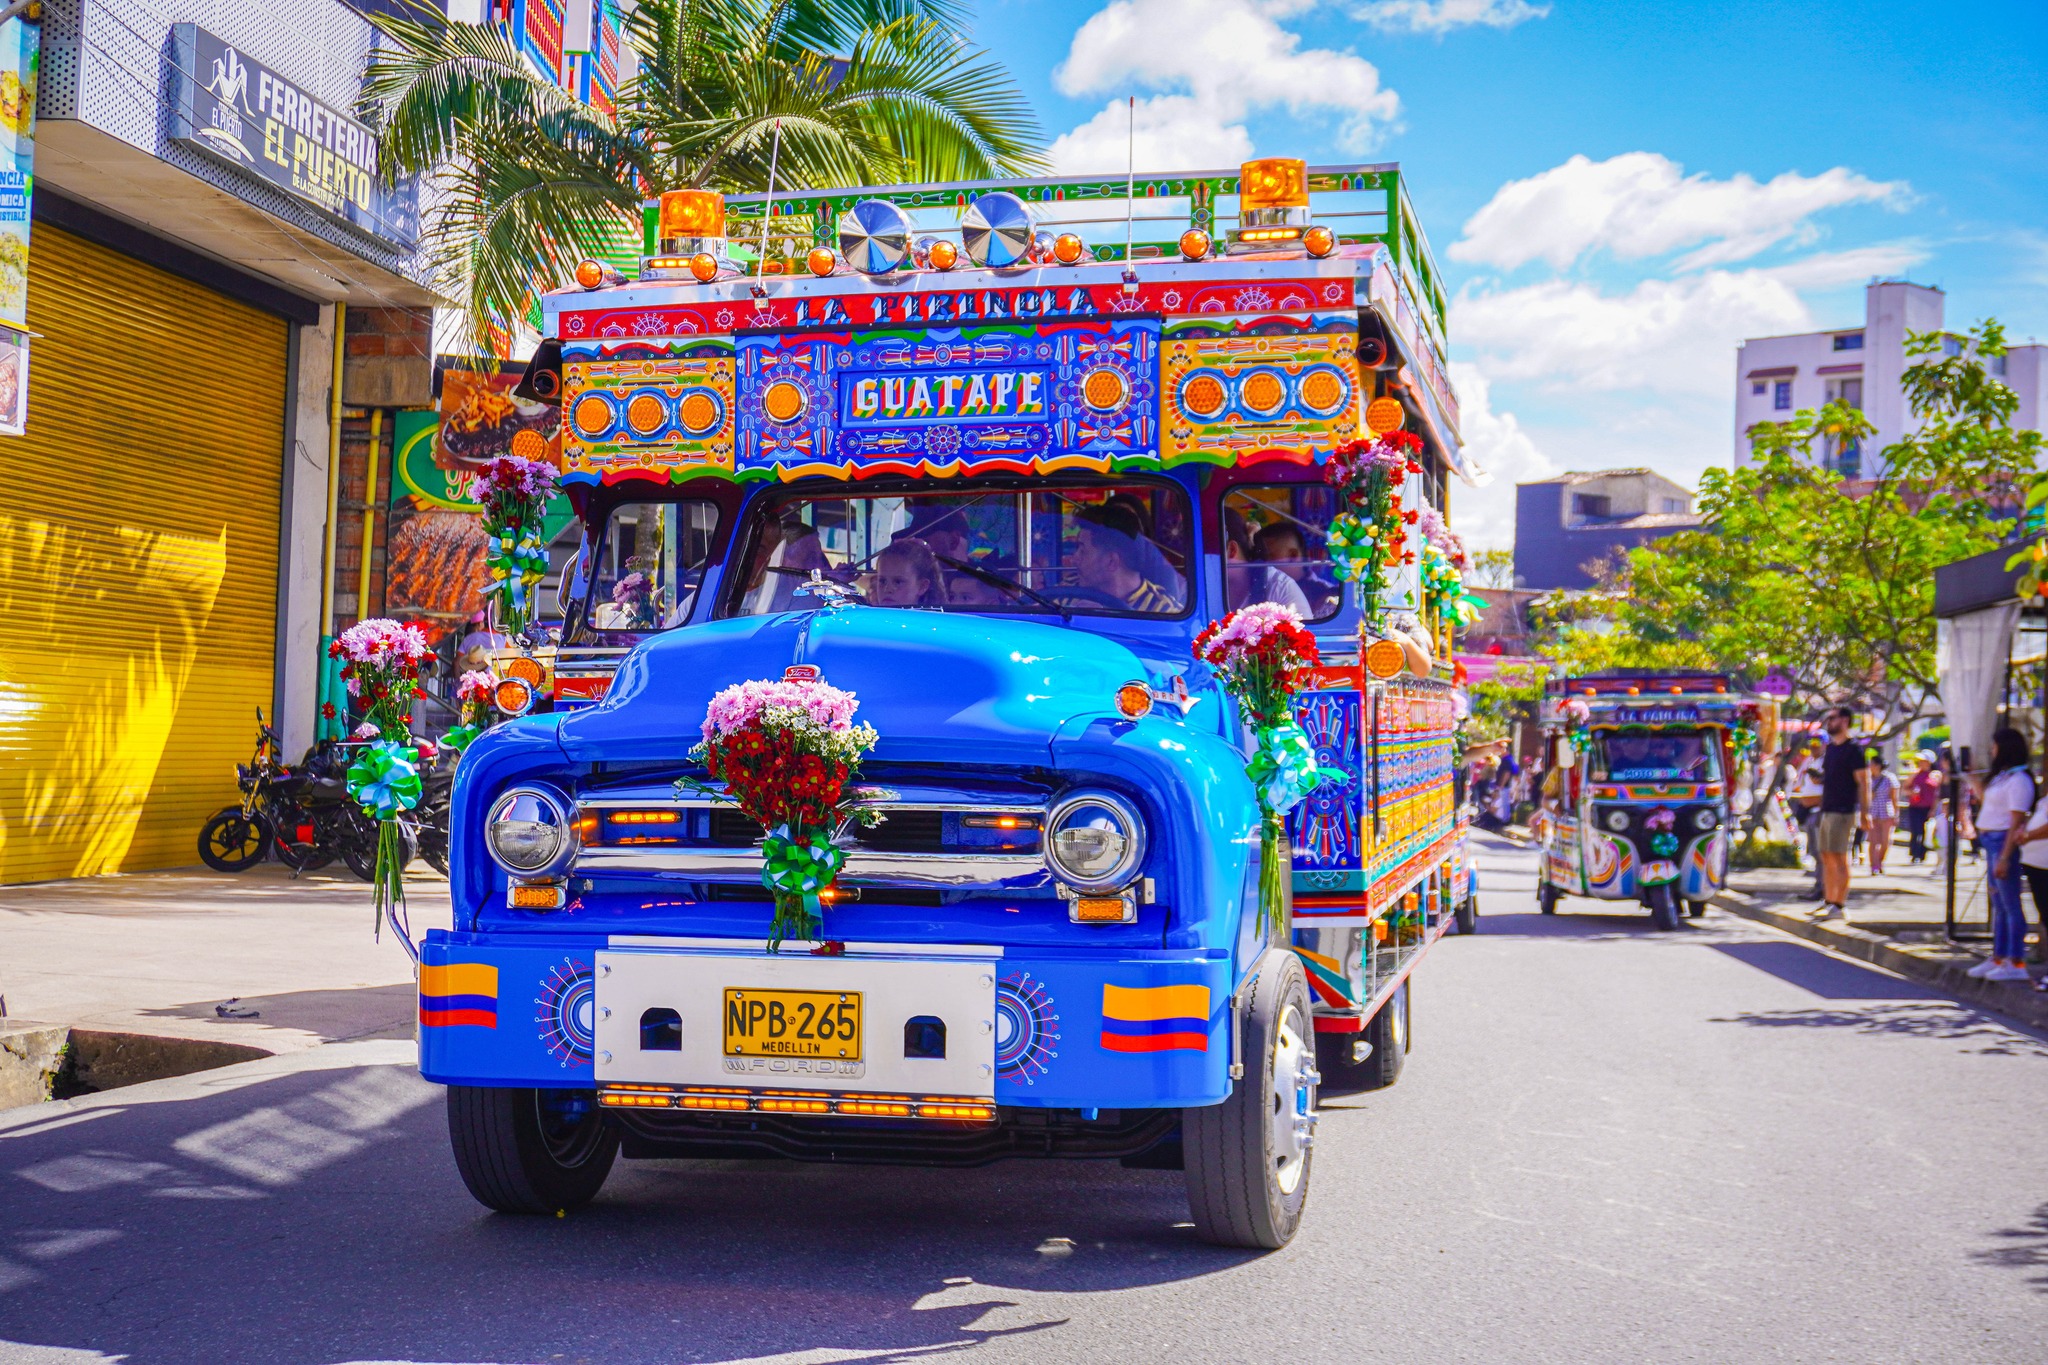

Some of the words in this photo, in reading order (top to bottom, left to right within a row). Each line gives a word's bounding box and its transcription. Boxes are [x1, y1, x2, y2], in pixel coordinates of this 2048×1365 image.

[212, 106, 220, 129] EL
[220, 110, 243, 140] PUERTO
[258, 70, 377, 176] FERRETERIA
[264, 117, 289, 169] EL
[293, 133, 371, 212] PUERTO
[292, 173, 300, 189] DE
[299, 177, 307, 193] LA
[0, 193, 25, 207] MICA
[794, 297, 852, 326] LA
[852, 371, 1046, 418] GUATAPE
[1152, 690, 1176, 701] ORD
[761, 1041, 821, 1054] MEDELLIN
[749, 1059, 837, 1074] FORD
